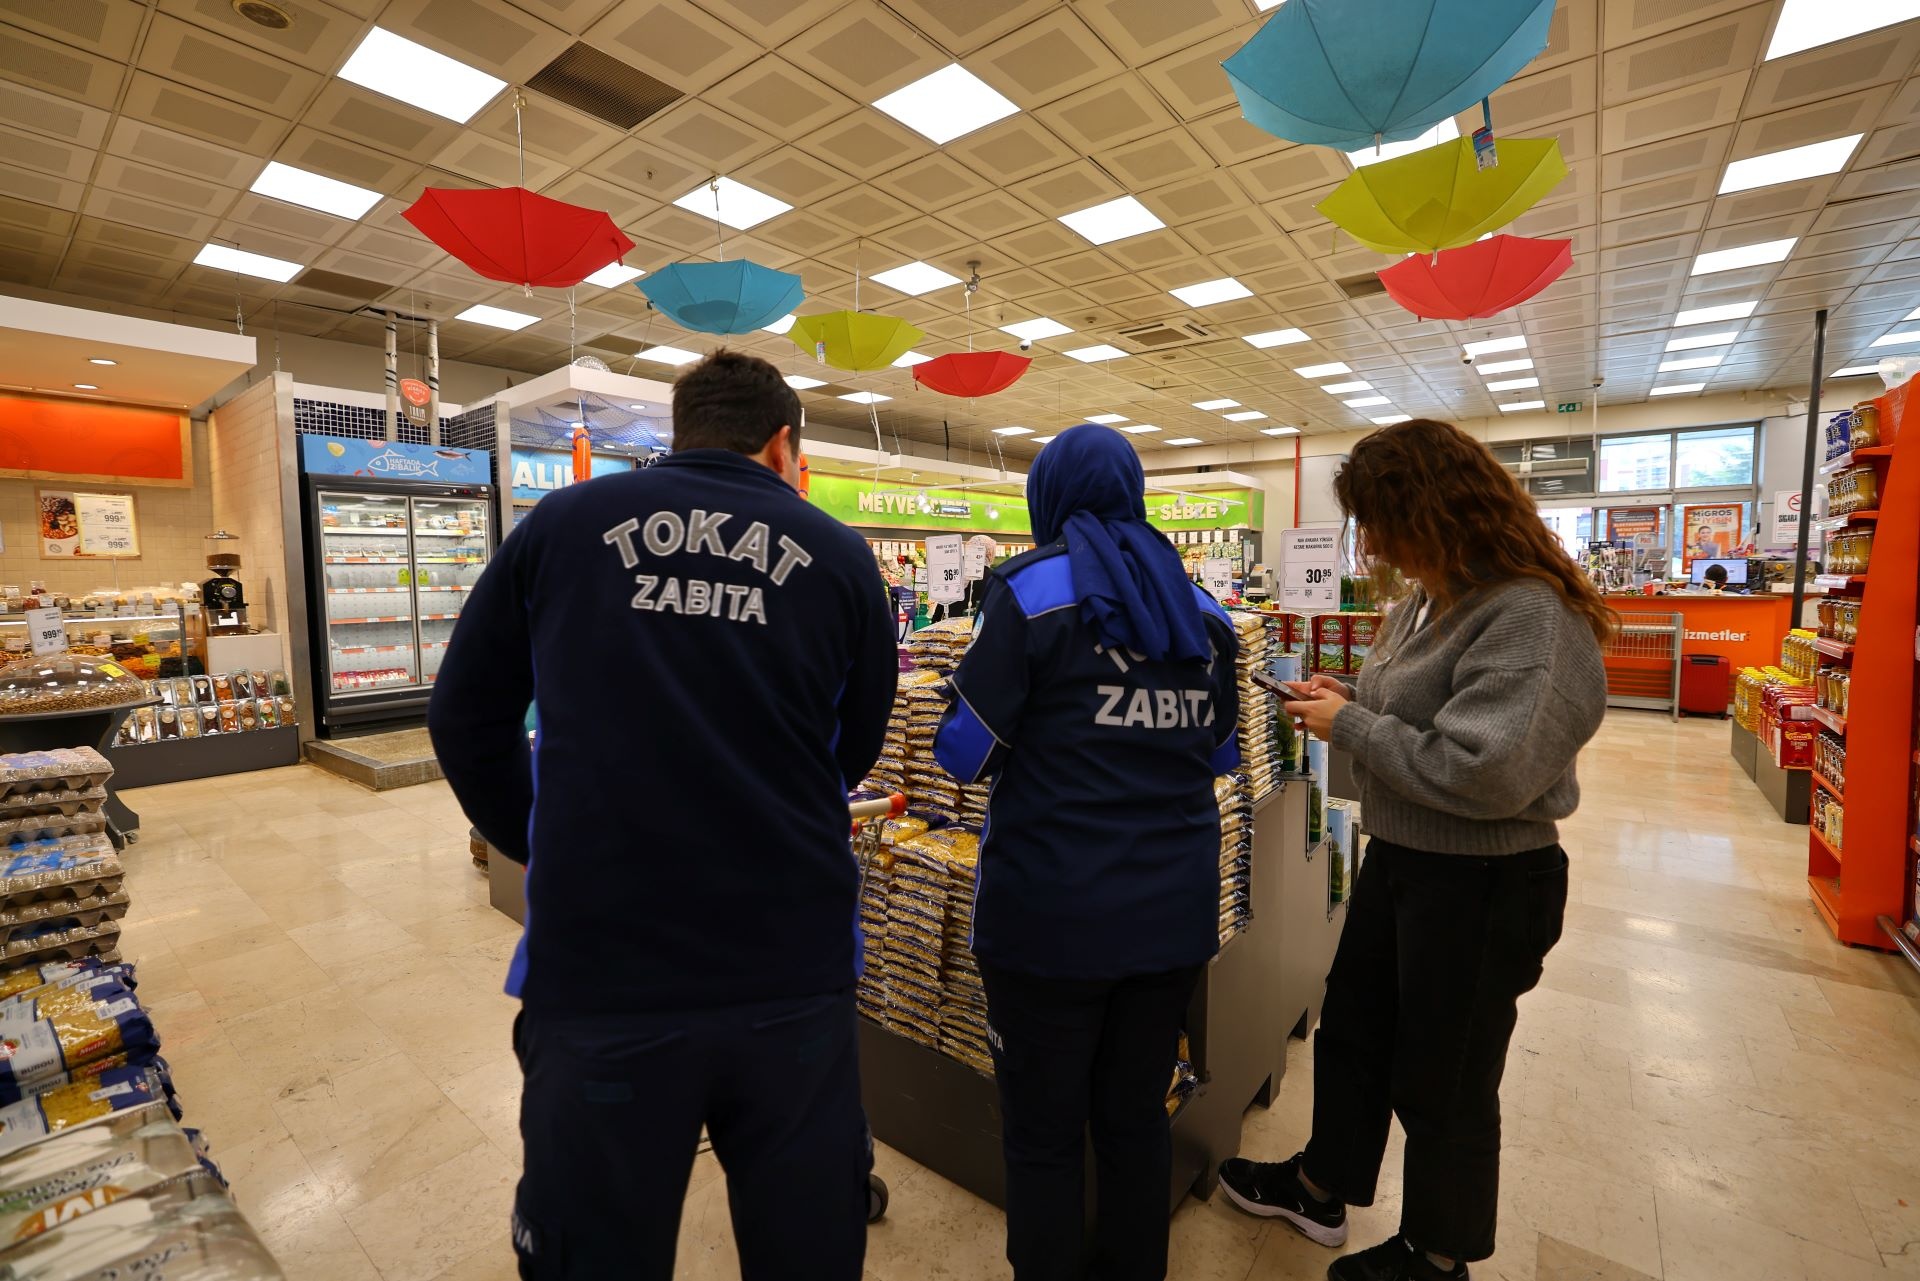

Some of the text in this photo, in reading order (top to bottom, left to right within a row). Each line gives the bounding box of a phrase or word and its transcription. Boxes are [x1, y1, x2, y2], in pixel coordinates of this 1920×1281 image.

[858, 492, 916, 515] MEYVE
[1160, 502, 1217, 521] SEBZE
[602, 509, 813, 586] TOKAT
[631, 575, 767, 625] ZABITA
